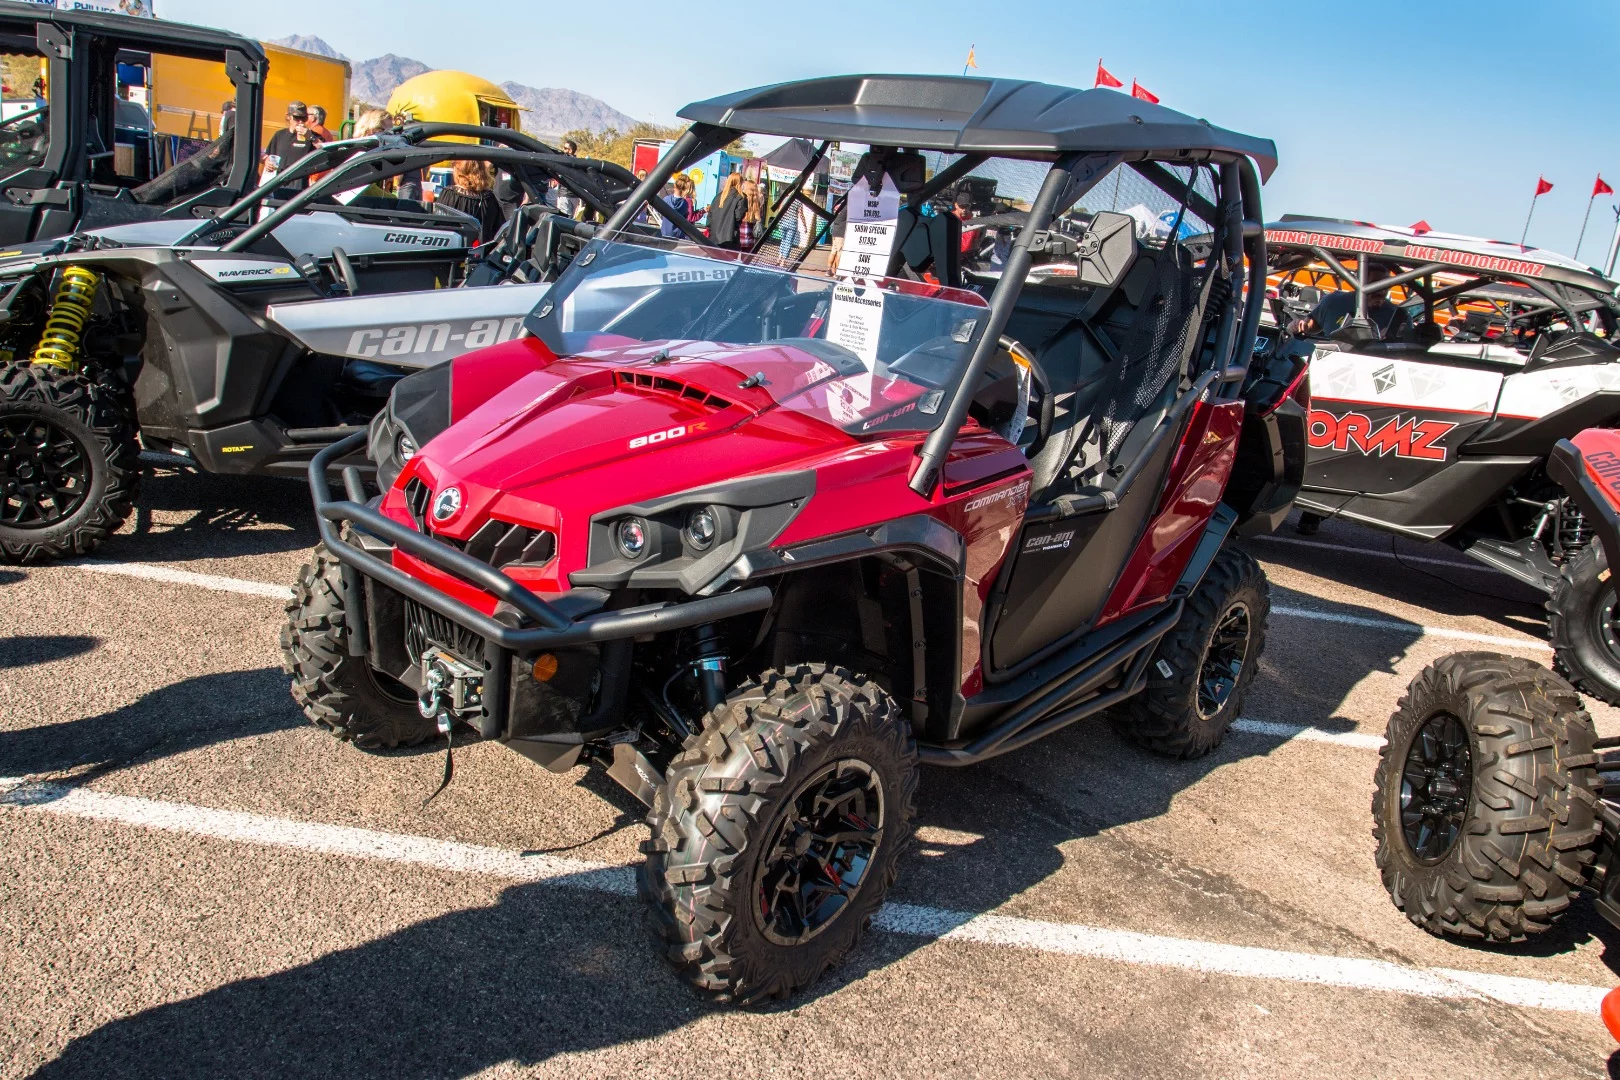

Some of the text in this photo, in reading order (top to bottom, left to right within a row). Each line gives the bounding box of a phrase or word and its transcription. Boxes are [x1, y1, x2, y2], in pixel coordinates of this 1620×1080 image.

[854, 224, 887, 235] SHOW SPECIAL
[384, 232, 450, 247] can-am
[1264, 230, 1384, 254] THING PERFORMZ
[858, 254, 871, 263] SAVE
[1404, 245, 1545, 277] LIKE AUDIOFORMZ
[218, 268, 272, 277] MAVERICK
[835, 293, 881, 308] Installed Accessories
[629, 421, 709, 449] 800R
[1308, 409, 1459, 461] ORMZ
[963, 481, 1030, 513] COMMANDER
[441, 503, 455, 512] BRP
[1026, 530, 1075, 548] can-am
